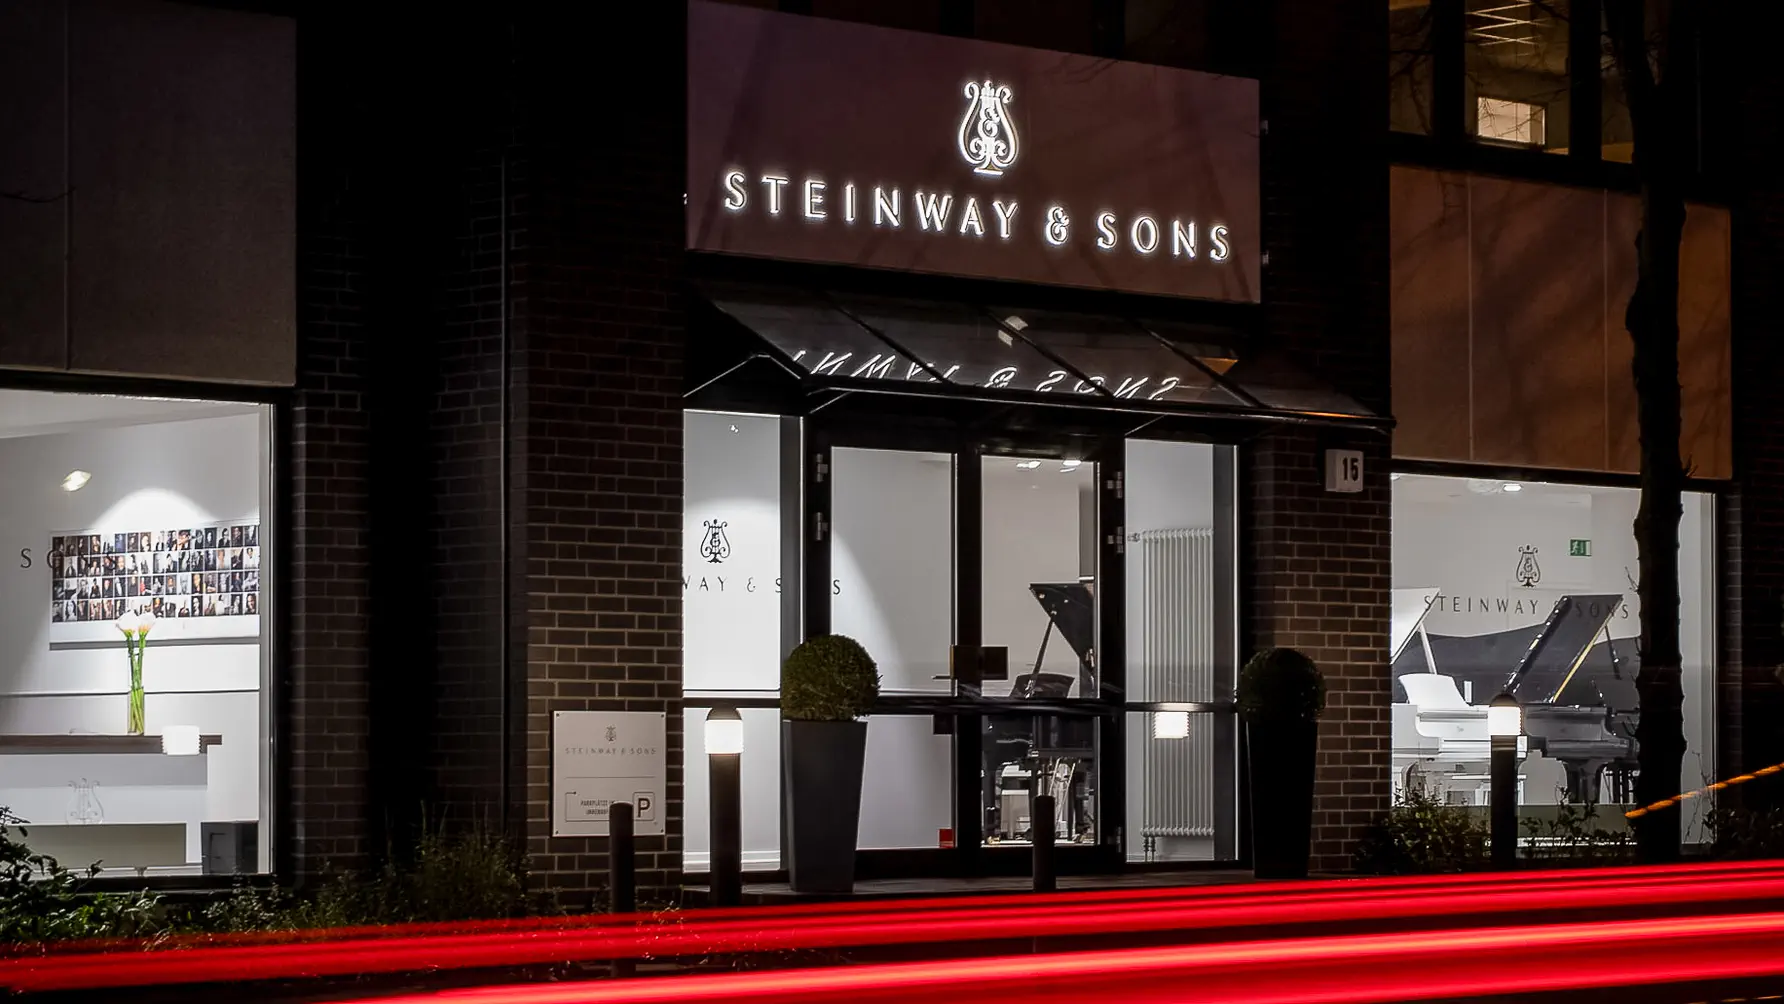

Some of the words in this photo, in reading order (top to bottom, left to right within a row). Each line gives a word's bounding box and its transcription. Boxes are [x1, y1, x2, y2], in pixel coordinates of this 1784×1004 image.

[724, 170, 1019, 240] STEINWAY
[1044, 205, 1071, 247] &
[1096, 211, 1233, 263] SONS
[1342, 456, 1360, 483] 15
[1423, 594, 1539, 615] STEINWAY
[637, 797, 651, 818] P
